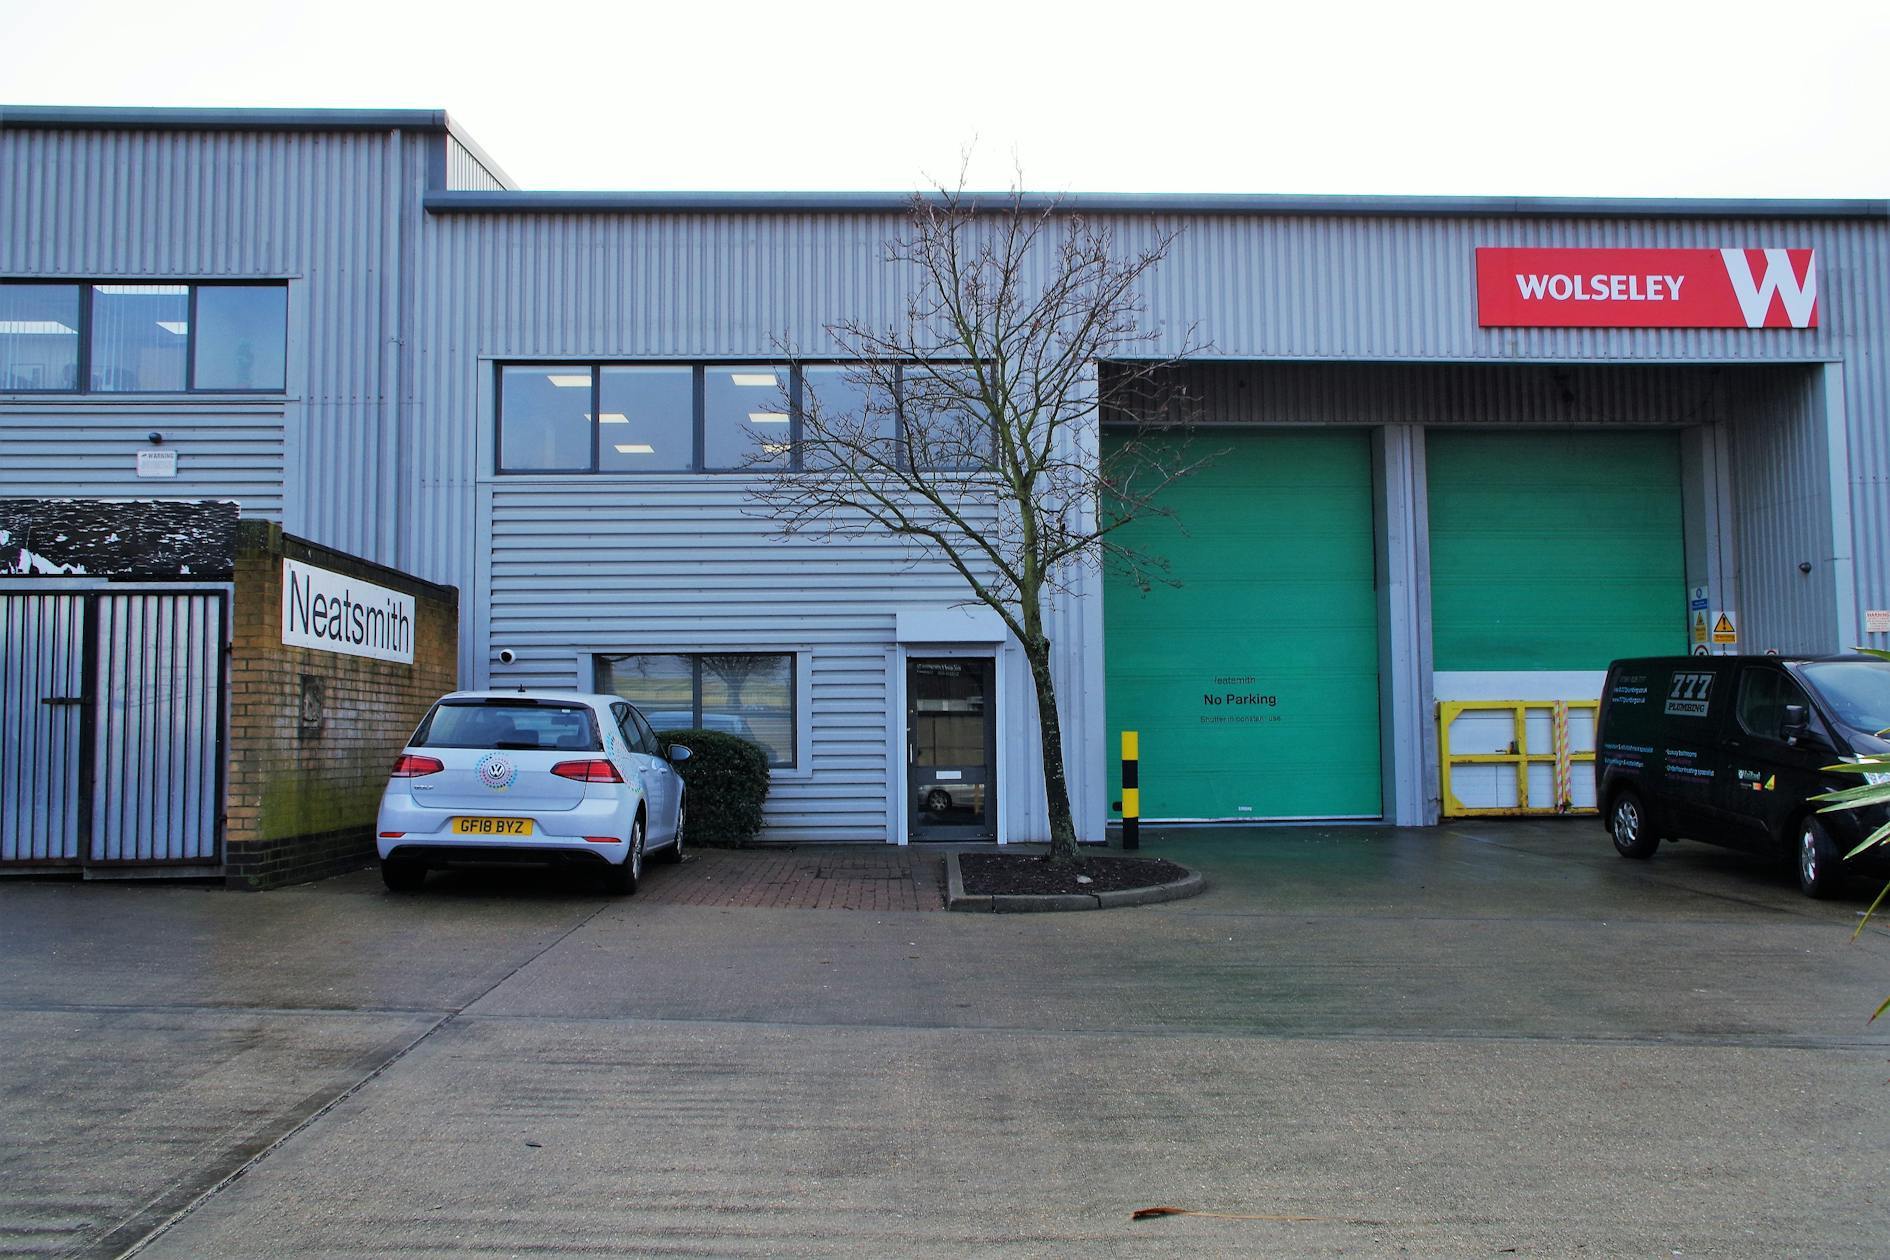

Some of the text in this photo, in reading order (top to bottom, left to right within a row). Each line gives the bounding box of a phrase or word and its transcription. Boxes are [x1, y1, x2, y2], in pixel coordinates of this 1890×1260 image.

[1515, 274, 1684, 301] WOLSELEY
[290, 570, 410, 654] Neatsmith
[1670, 674, 1712, 699] 777
[1204, 693, 1277, 707] No Parking
[1668, 702, 1705, 713] PLUMBING
[461, 819, 524, 833] GF18 BYZ
